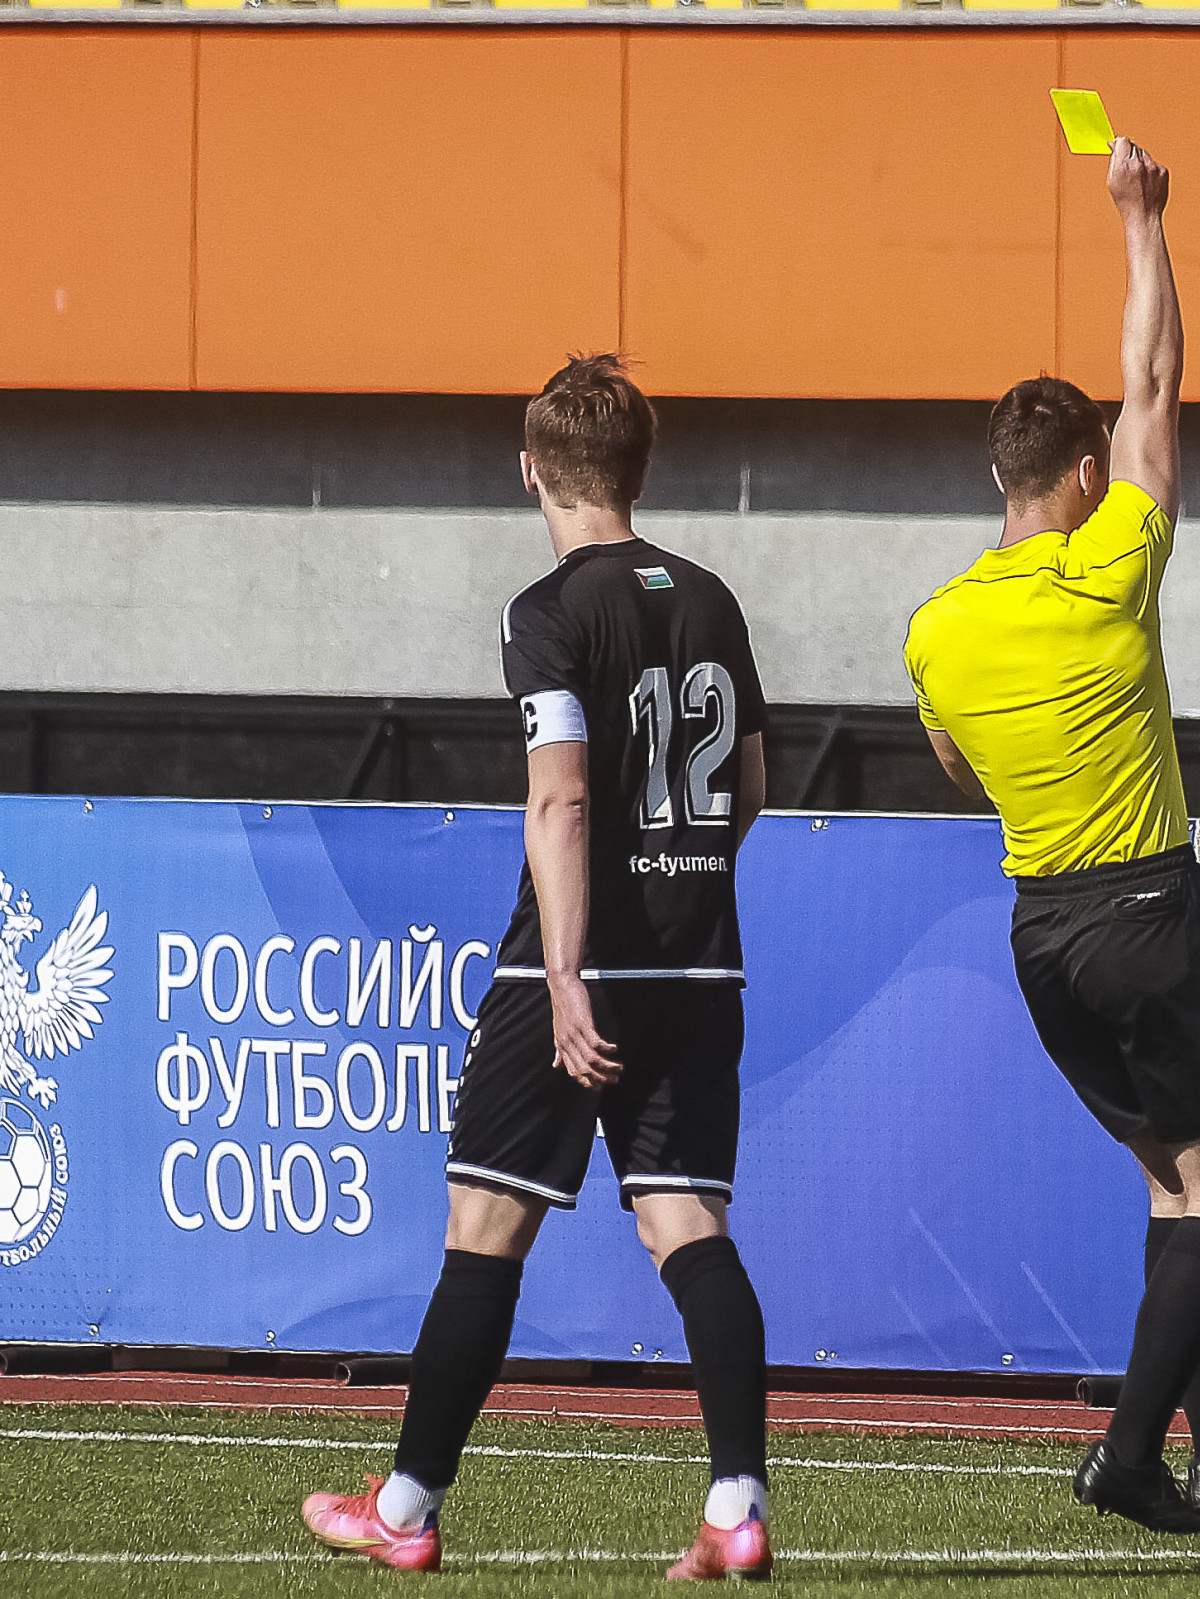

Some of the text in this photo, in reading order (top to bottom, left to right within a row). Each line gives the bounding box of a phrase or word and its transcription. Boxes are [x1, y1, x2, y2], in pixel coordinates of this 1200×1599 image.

[523, 701, 538, 743] C
[629, 662, 736, 830] 12
[628, 852, 728, 874] fc-tyumen
[156, 924, 501, 1030] РОССИЙС
[159, 1139, 373, 1236] СОЮЗ
